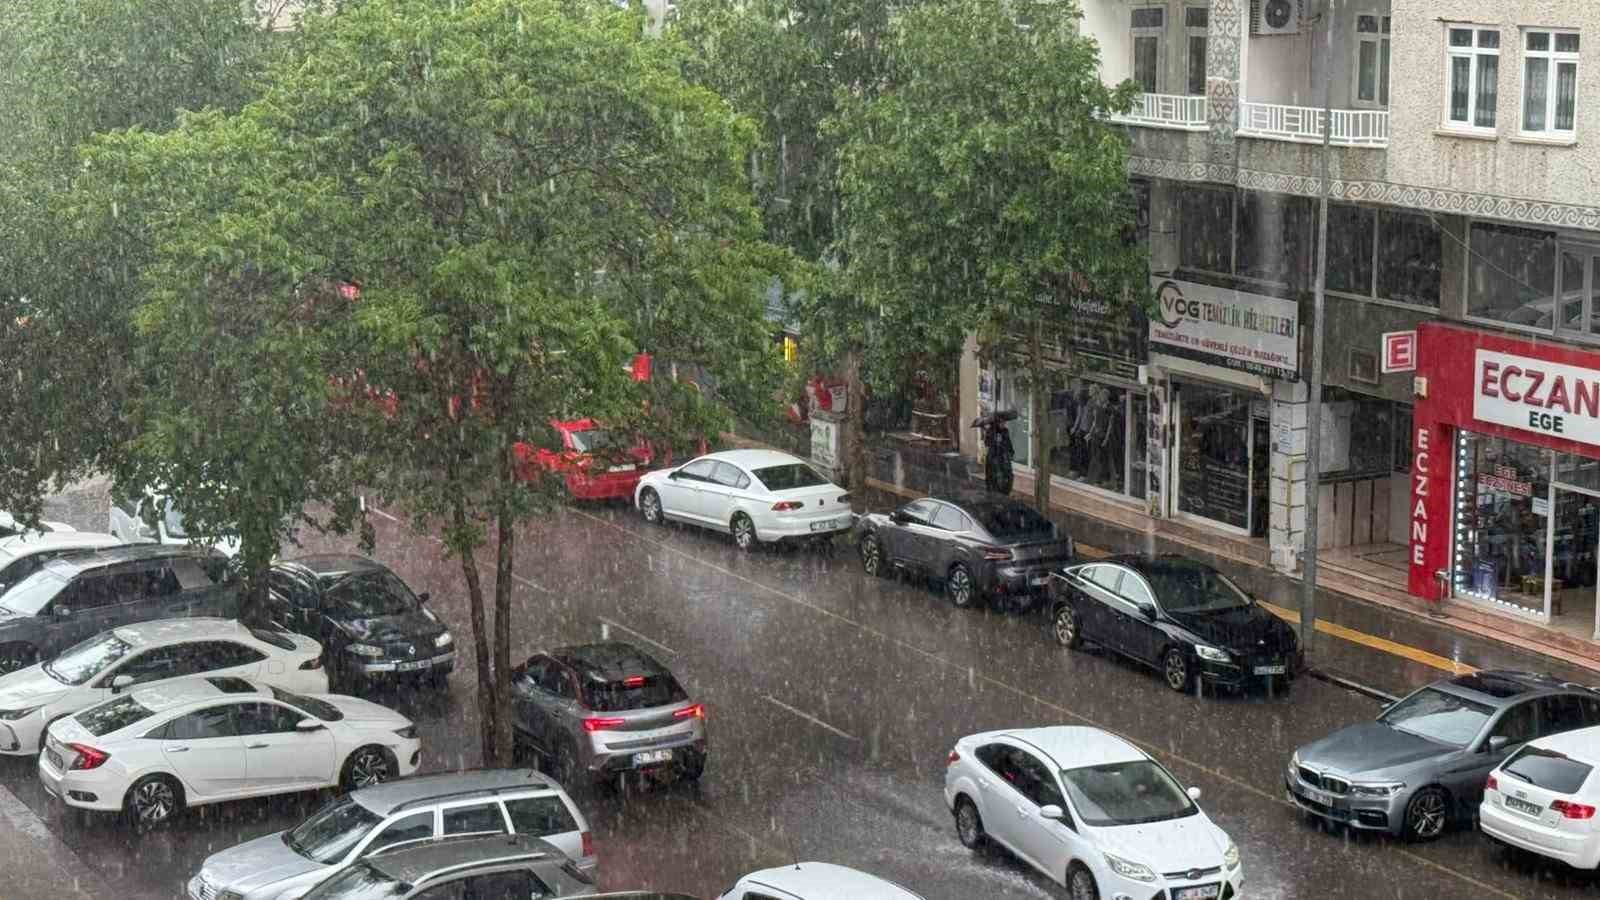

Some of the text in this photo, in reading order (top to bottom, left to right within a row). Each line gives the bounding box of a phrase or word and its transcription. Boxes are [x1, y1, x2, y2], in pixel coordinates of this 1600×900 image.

[1391, 338, 1410, 366] E
[1481, 360, 1600, 419] ECZAN
[1529, 410, 1563, 433] EGE
[1412, 428, 1430, 567] ECZANE
